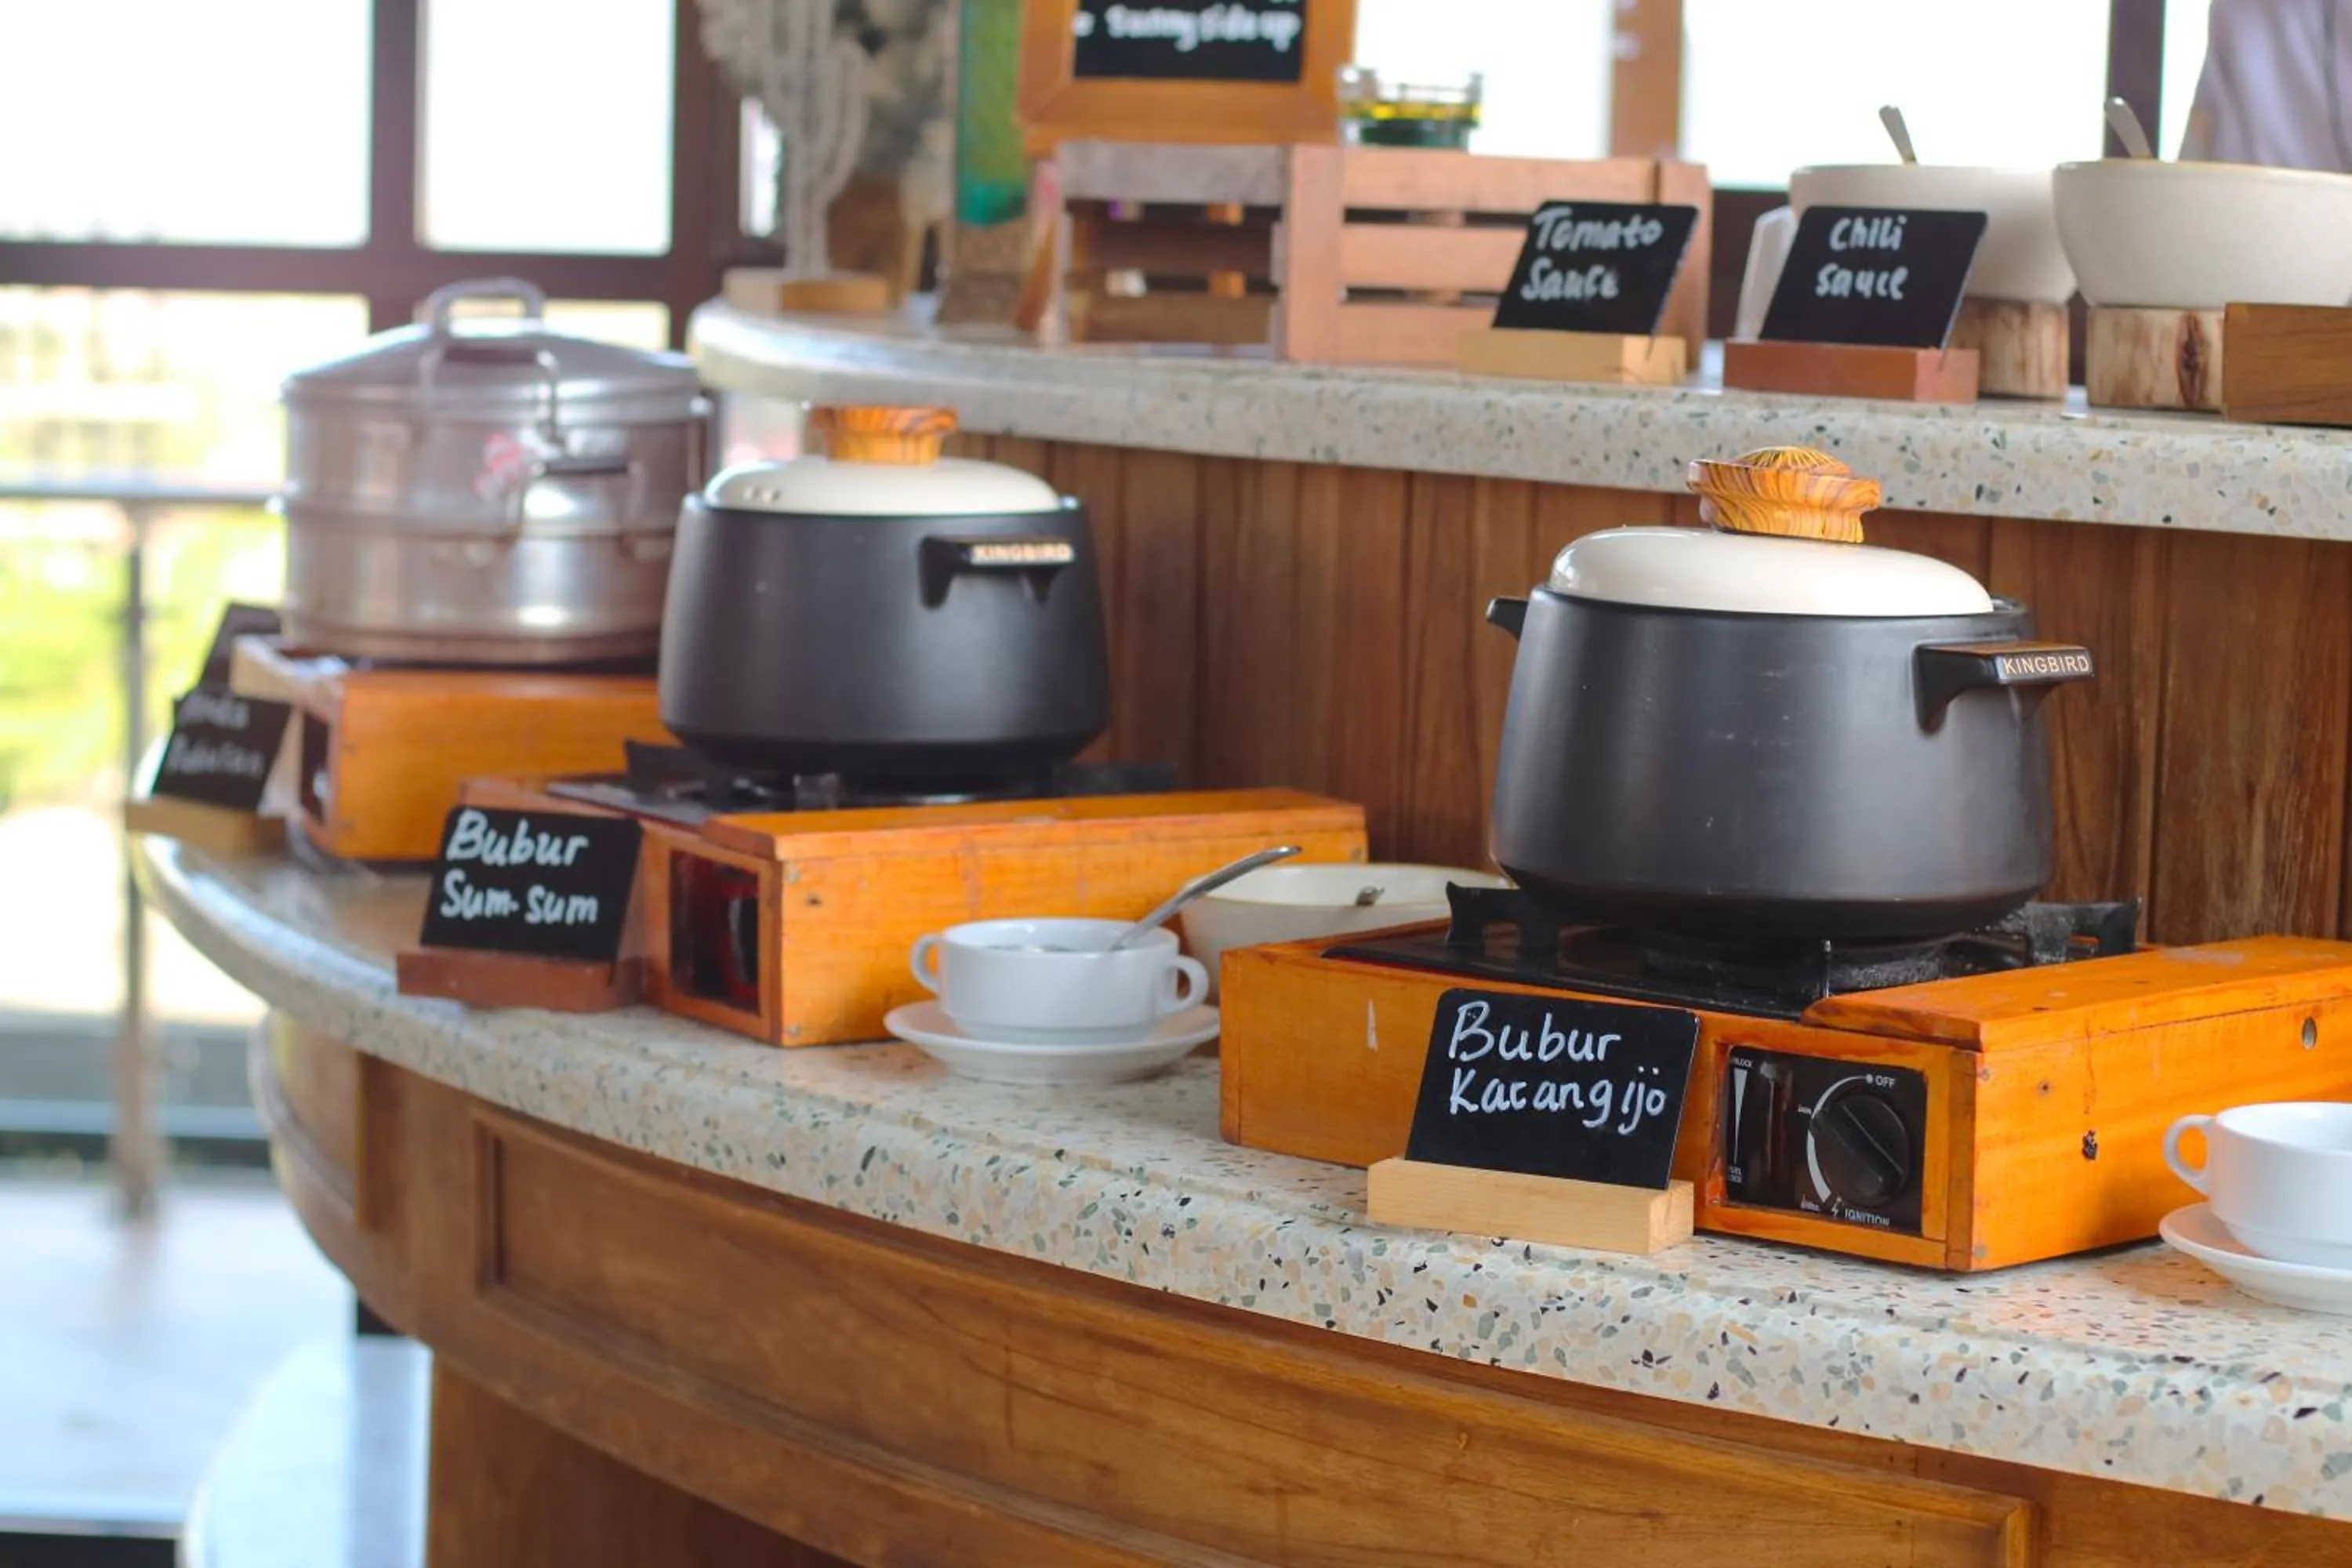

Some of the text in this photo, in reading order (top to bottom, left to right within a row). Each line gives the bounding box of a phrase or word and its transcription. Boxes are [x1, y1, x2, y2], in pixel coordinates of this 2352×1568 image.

[1533, 205, 1663, 251] Tomato
[1521, 256, 1618, 300] Sauce
[2003, 655, 2089, 676] KINGBIRD
[446, 809, 590, 866] Bubur
[1449, 1000, 1621, 1062] Bubur
[1875, 1075, 1896, 1088] OFF
[1844, 1208, 1890, 1226] IGNITION
